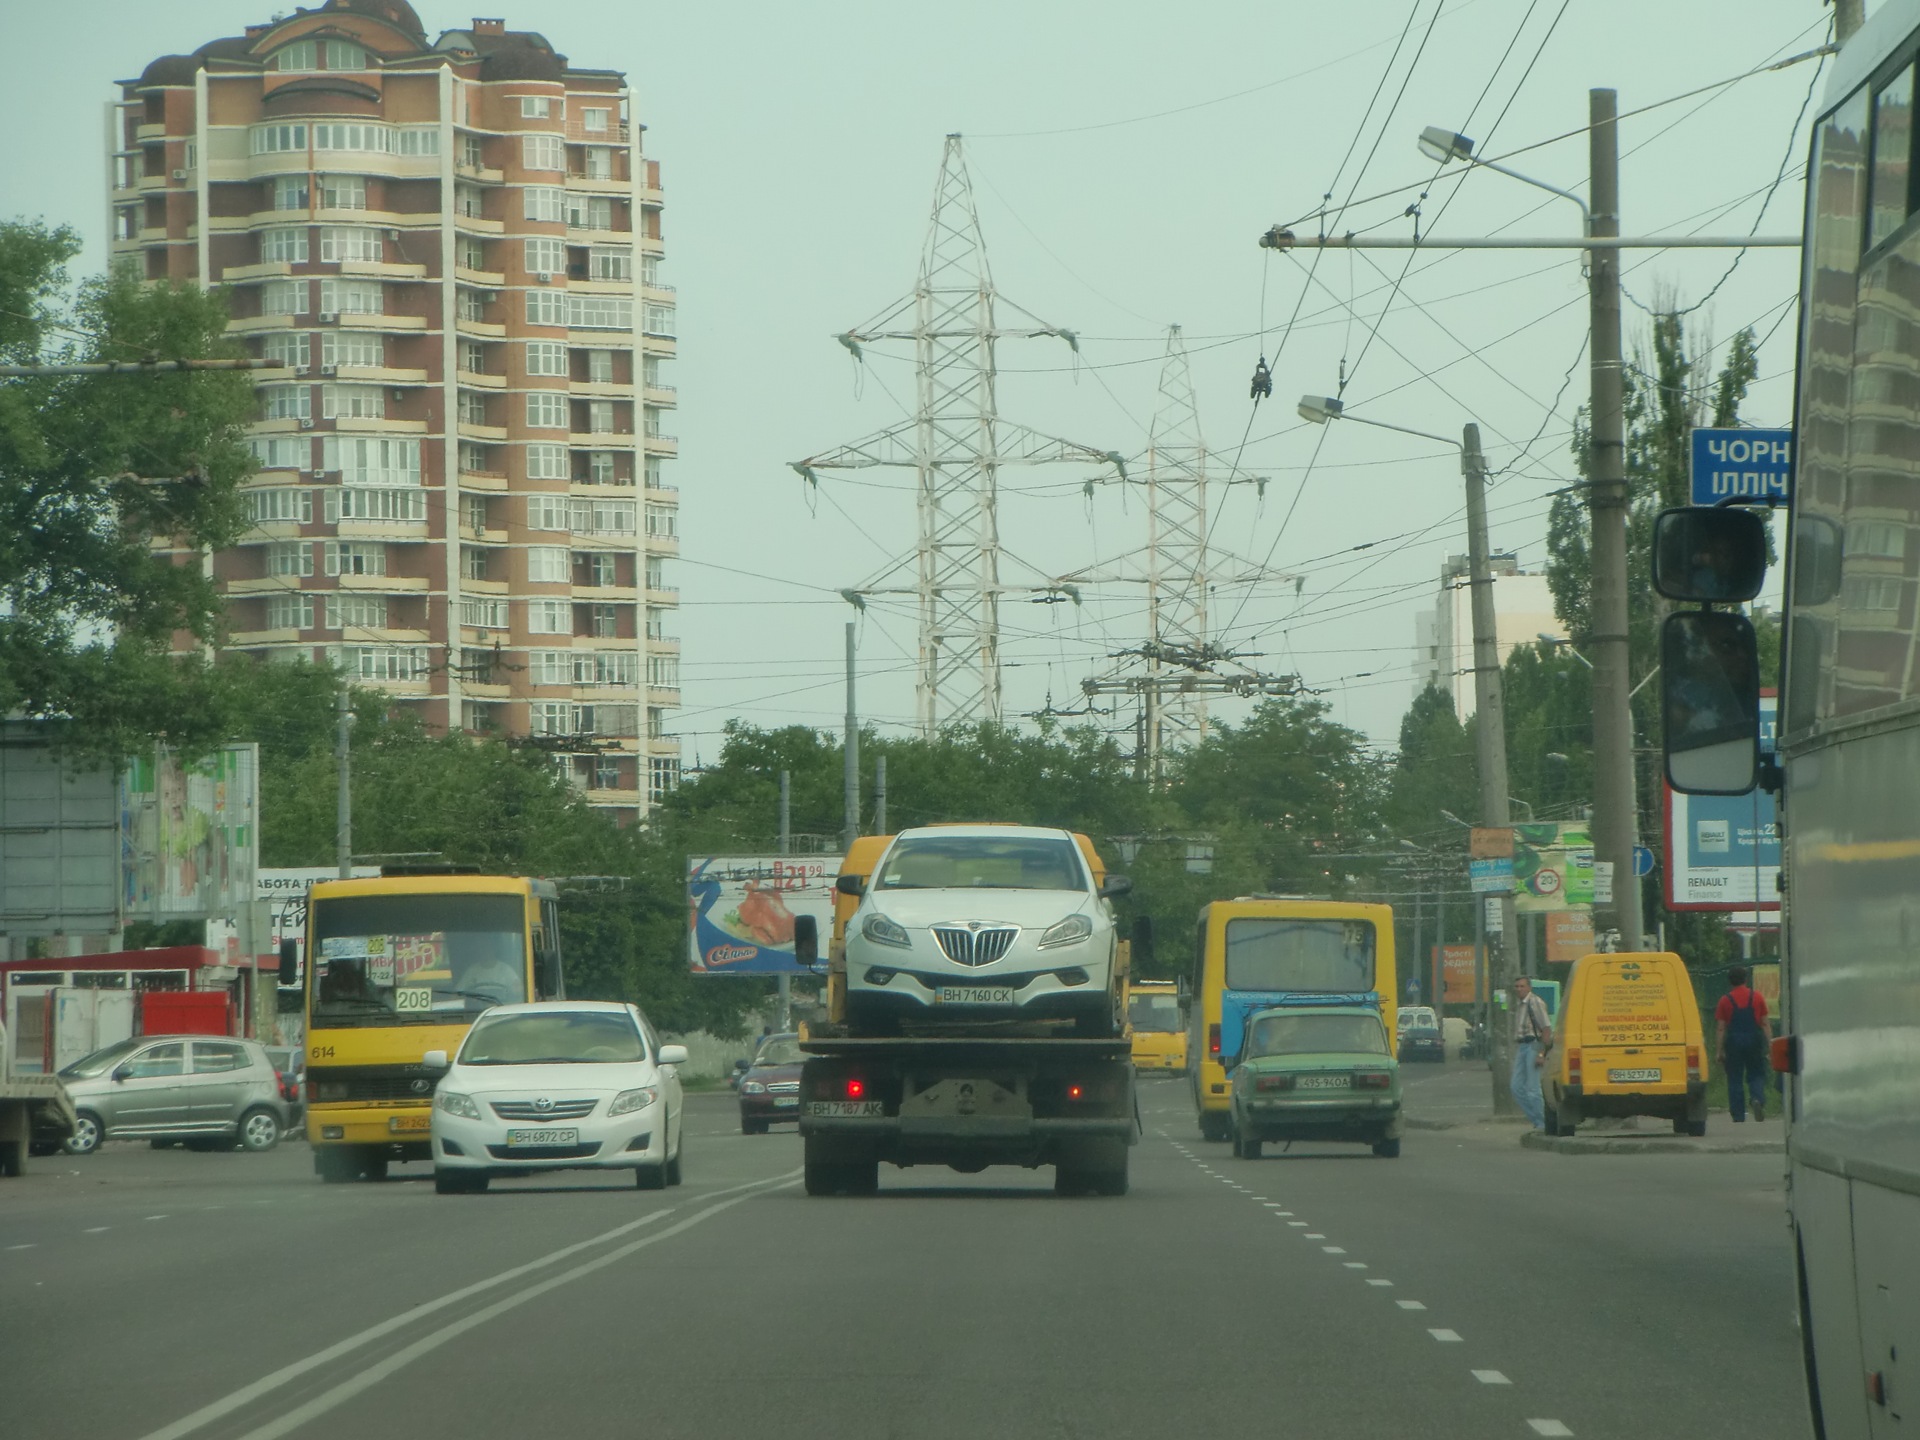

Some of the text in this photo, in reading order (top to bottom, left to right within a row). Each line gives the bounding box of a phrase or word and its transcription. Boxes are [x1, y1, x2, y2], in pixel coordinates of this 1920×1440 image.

[257, 879, 301, 889] АБОТА
[1688, 877, 1728, 887] RENAULT
[1688, 890, 1722, 899] Finance
[398, 991, 430, 1009] 208
[944, 989, 1010, 1001] BH 7160 CK
[312, 1046, 335, 1058] 614
[814, 1103, 830, 1114] BH
[515, 1131, 575, 1142] BH 6872 CP
